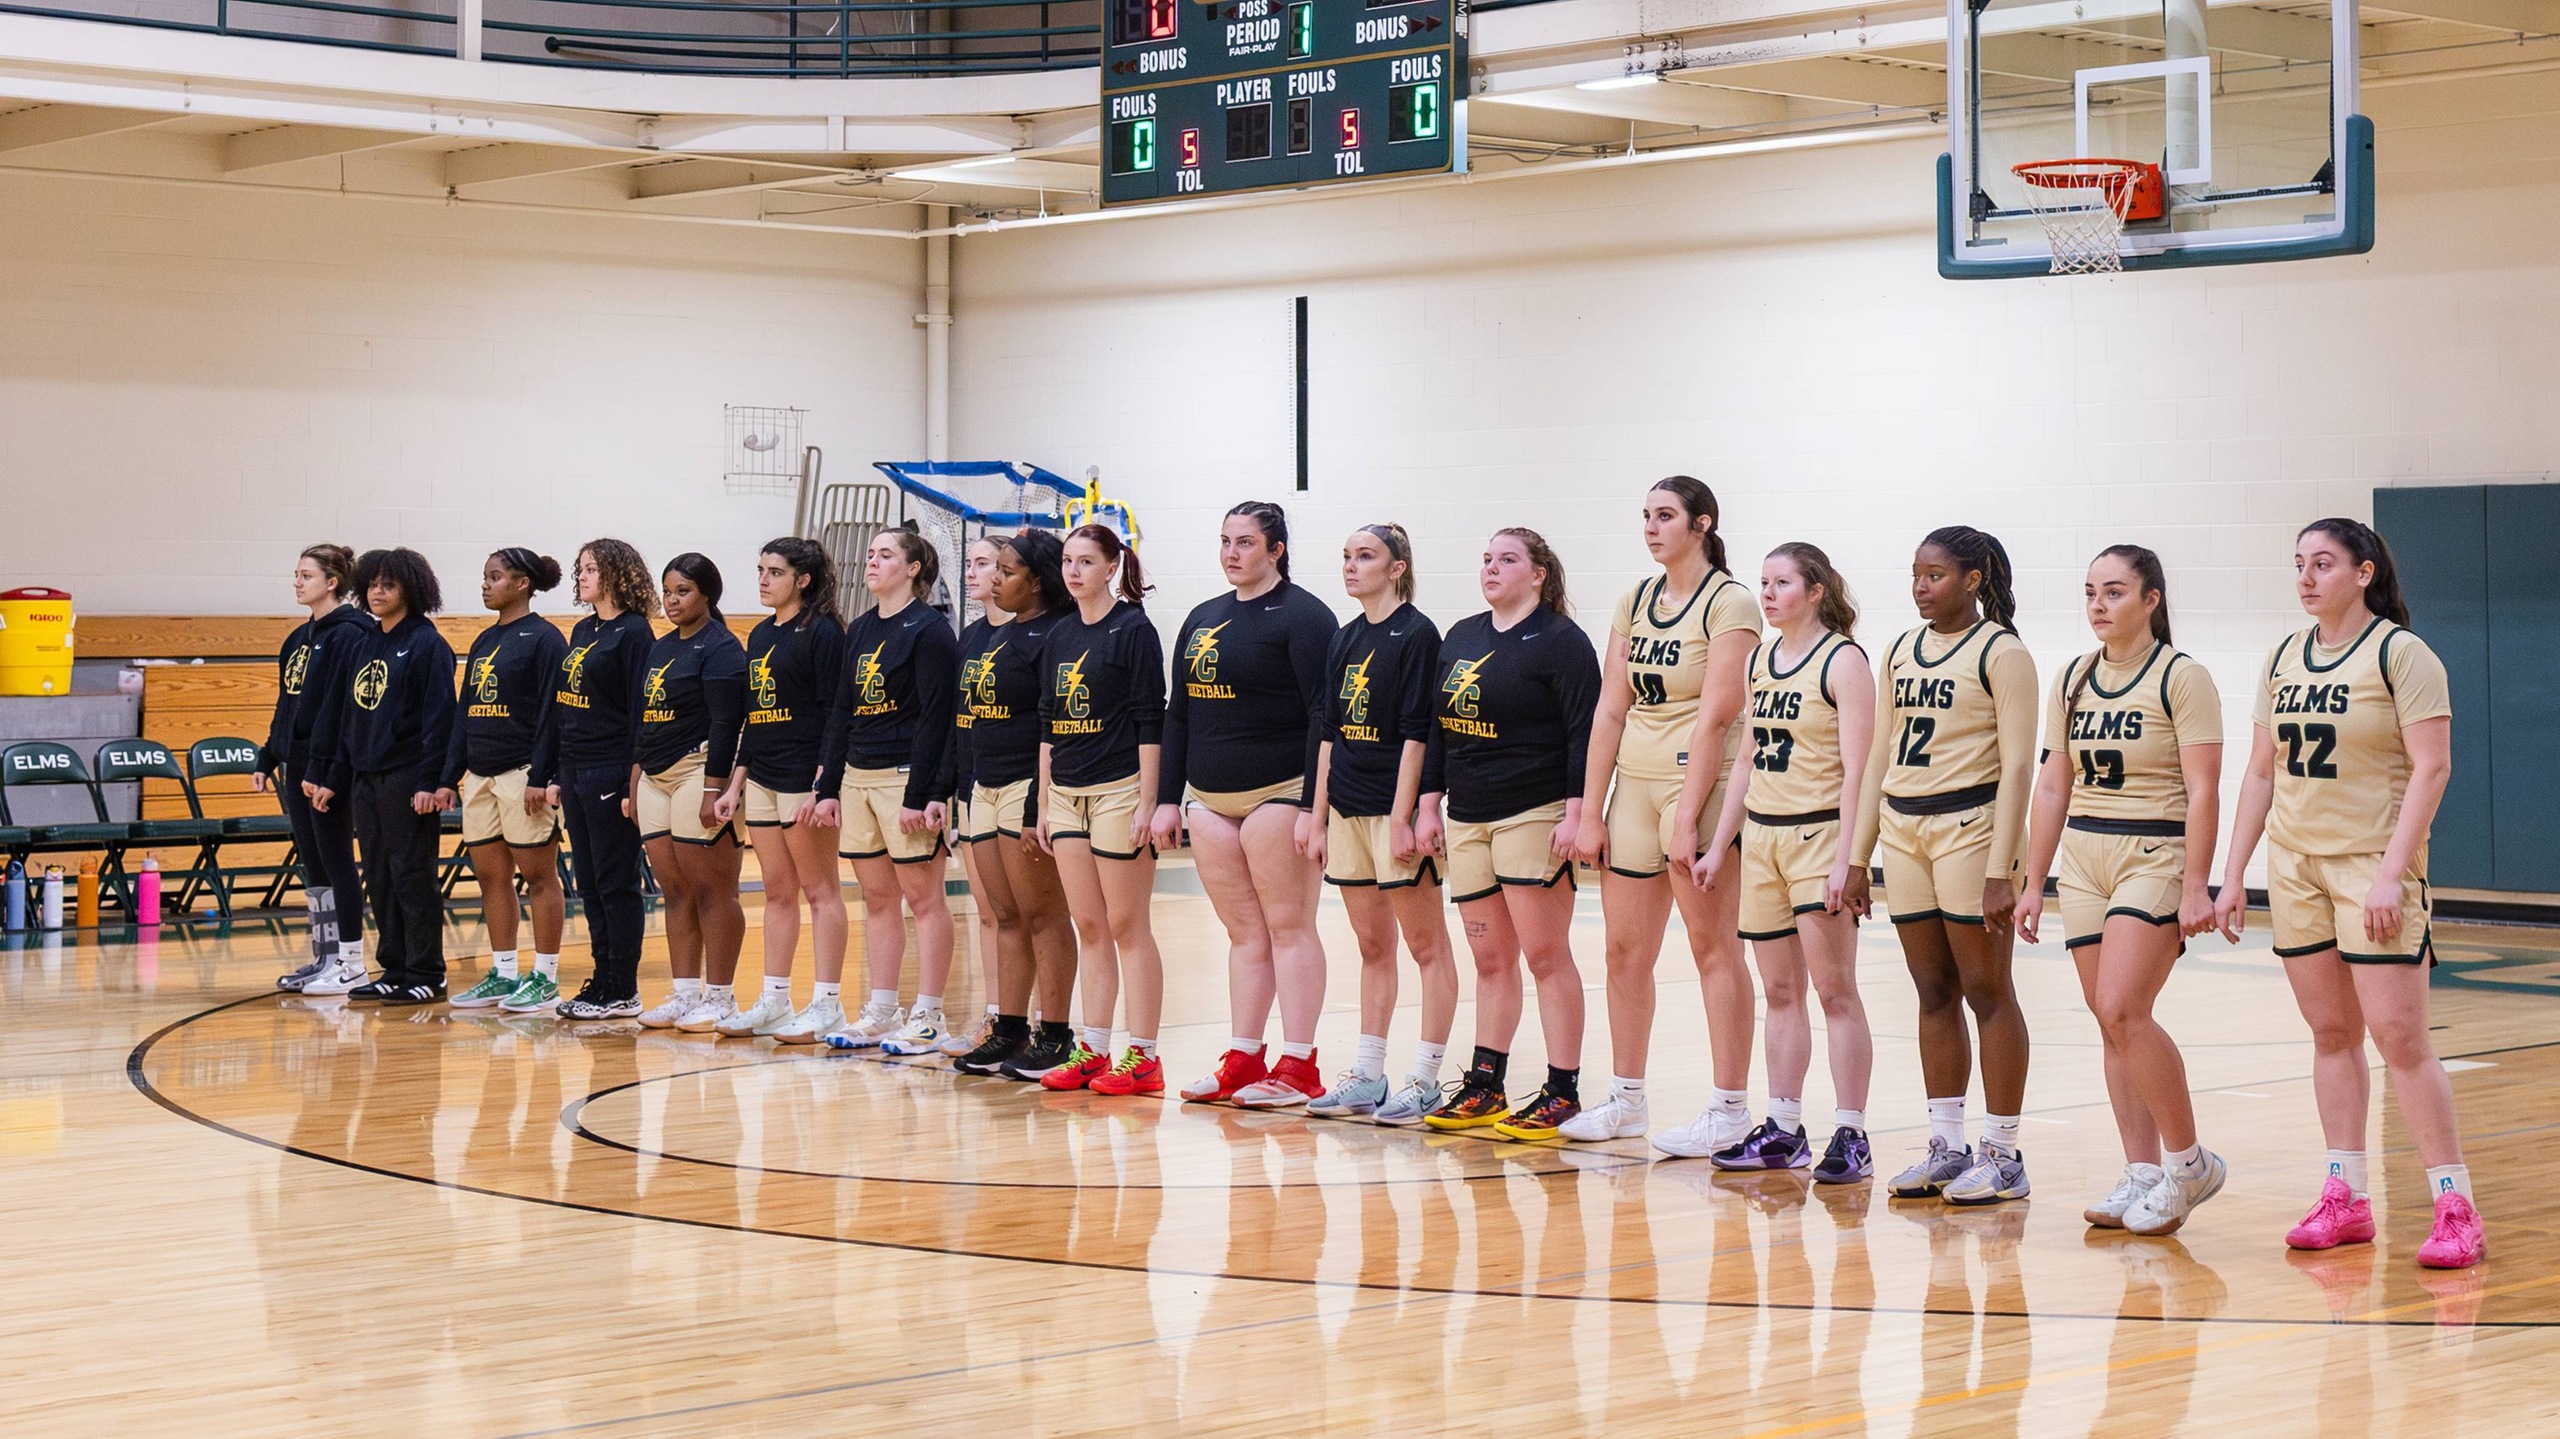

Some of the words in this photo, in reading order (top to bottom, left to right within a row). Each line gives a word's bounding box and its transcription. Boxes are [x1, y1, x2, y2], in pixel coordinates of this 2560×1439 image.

[1239, 0, 1268, 19] POSS
[1226, 18, 1280, 46] PERIOD
[1301, 4, 1311, 55] 1
[1355, 15, 1409, 44] BONUS
[1139, 47, 1187, 74] BONUS
[1229, 42, 1277, 57] FAIR-PLAY
[1288, 69, 1336, 96] FOULS
[1391, 54, 1442, 83] FOULS
[1112, 93, 1157, 119] FOULS
[1217, 77, 1272, 106] PLAYER
[1413, 84, 1438, 138] 0
[1343, 112, 1358, 146] 5
[1133, 121, 1154, 170] 0
[1183, 132, 1197, 165] 5
[1334, 151, 1364, 175] TOL
[1176, 169, 1204, 192] TOL
[1628, 636, 1681, 667] ELMS
[1752, 690, 1802, 720] ELMS
[1894, 677, 1955, 710] ELMS
[2275, 683, 2350, 715] ELMS
[2070, 711, 2143, 741] ELMS
[201, 748, 255, 764] ELMS
[1752, 727, 1794, 773] 23
[1896, 716, 1936, 767] 12
[2278, 722, 2337, 779] 22
[13, 753, 71, 770] ELMS
[109, 750, 167, 766] ELMS
[2079, 749, 2125, 790] 13
